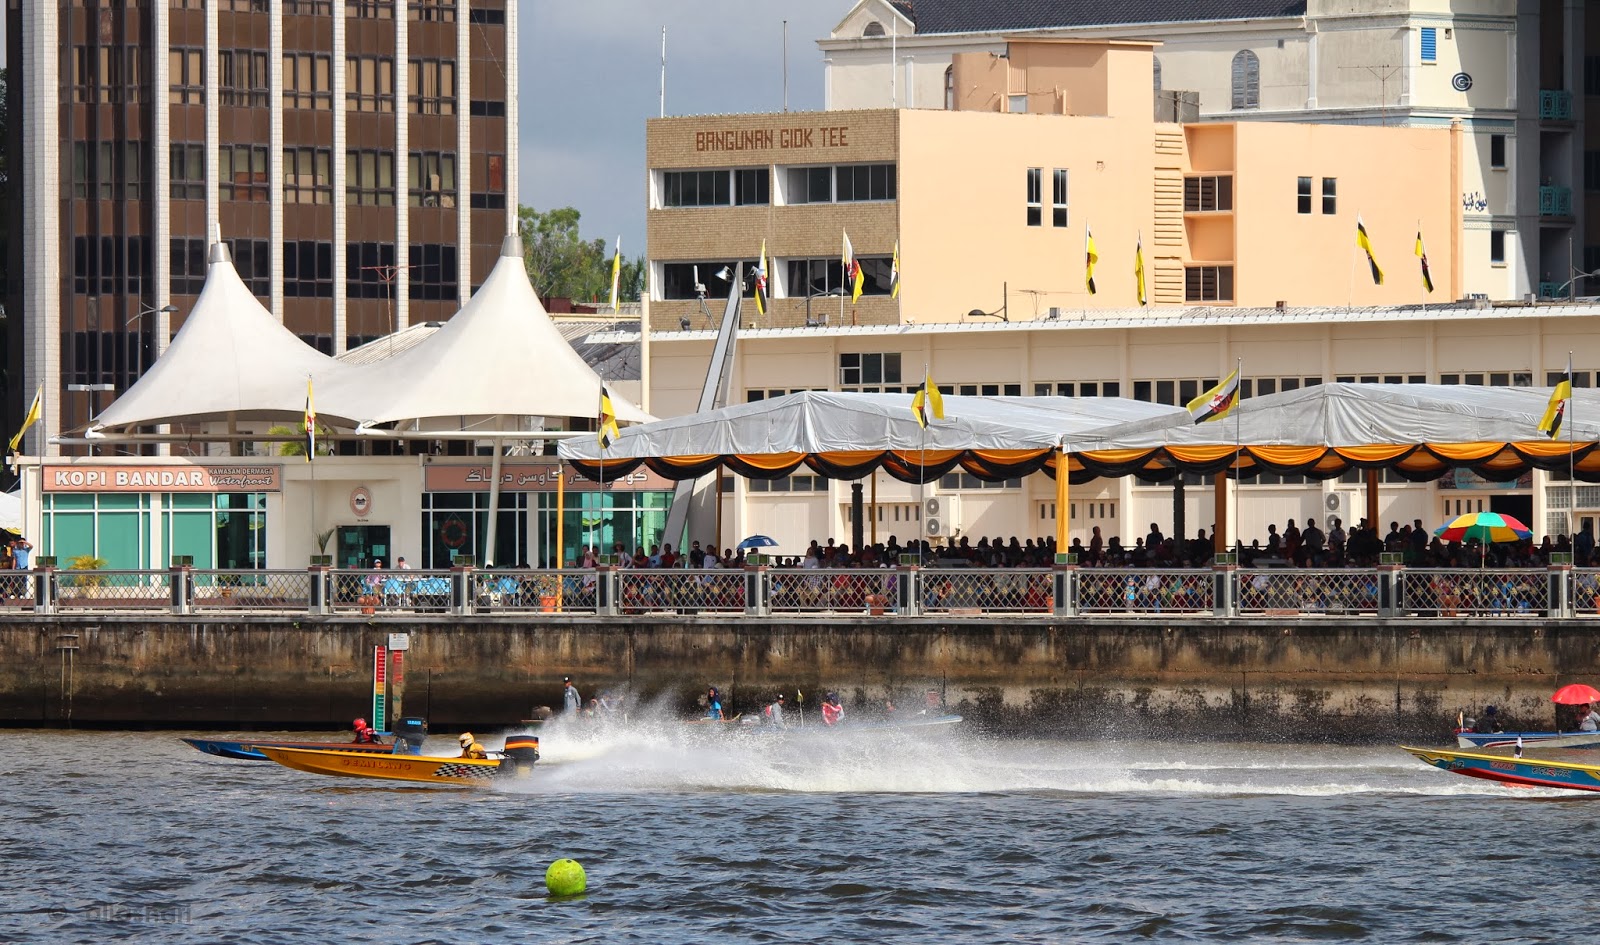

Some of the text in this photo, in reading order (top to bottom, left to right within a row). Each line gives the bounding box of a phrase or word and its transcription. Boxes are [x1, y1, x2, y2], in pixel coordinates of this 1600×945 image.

[696, 127, 849, 151] BANGUNAN GIOK TEE
[55, 470, 204, 486] KOPI BANDAR
[208, 467, 274, 475] KAWASAN DERMAGA
[208, 474, 273, 488] Waterfront
